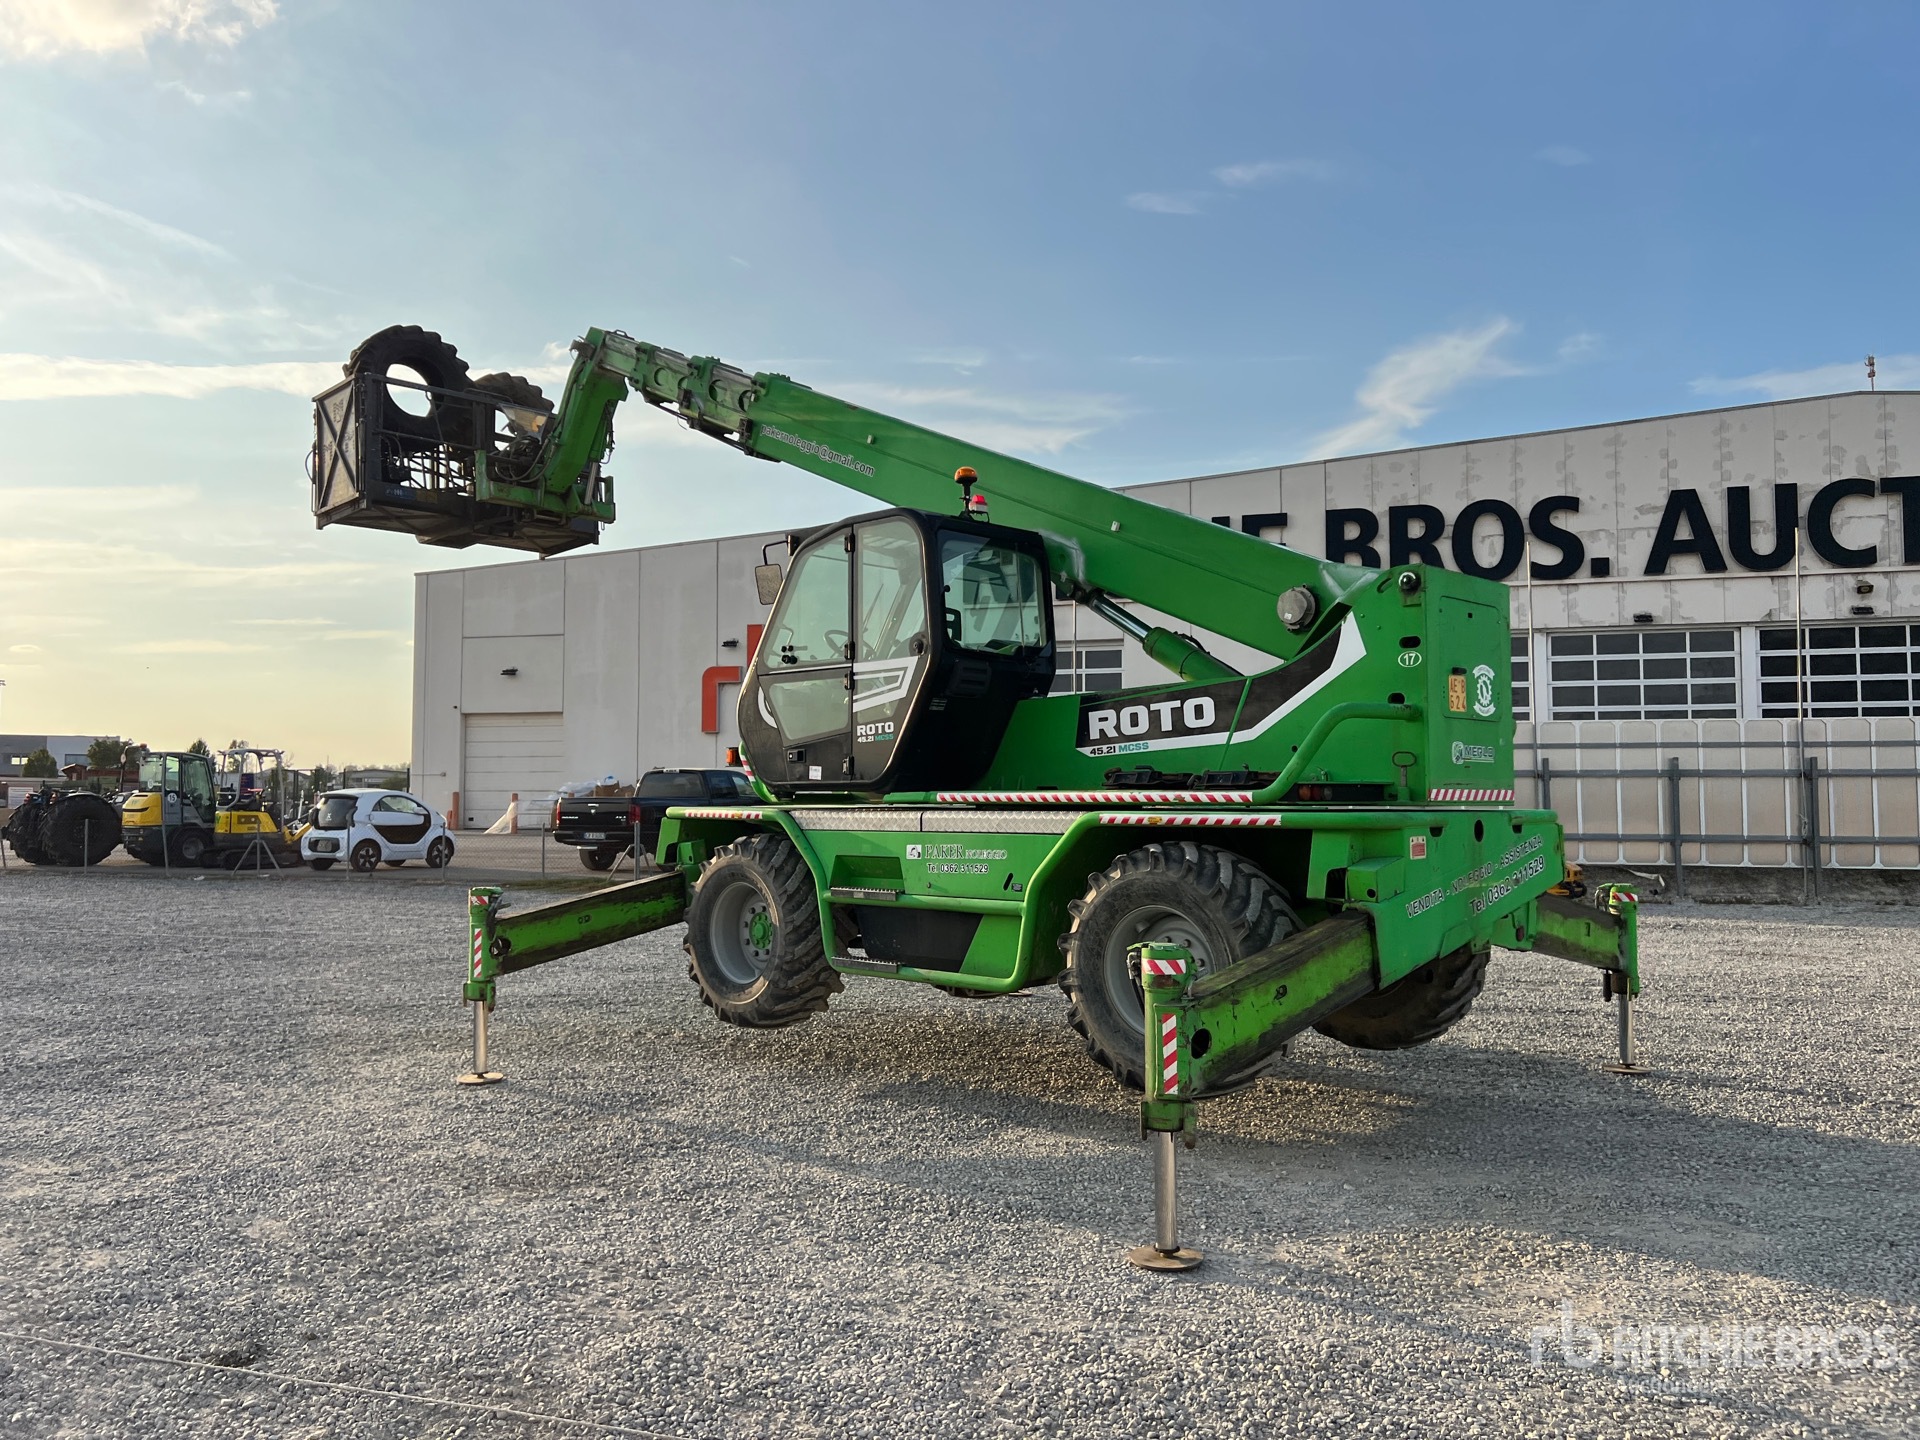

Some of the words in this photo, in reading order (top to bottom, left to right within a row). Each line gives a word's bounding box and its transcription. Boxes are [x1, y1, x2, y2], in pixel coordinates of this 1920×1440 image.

[761, 423, 875, 477] pakernoleggio@gmail.com
[1325, 496, 1611, 580] BROS.
[1643, 475, 1920, 575] AUCT
[1403, 653, 1415, 666] 17
[1088, 696, 1216, 740] ROTO
[857, 721, 895, 737] ROTO
[875, 733, 894, 741] MCSS
[1118, 742, 1150, 753] MCSS
[925, 844, 964, 859] PAKER
[940, 863, 959, 873] 0362
[960, 863, 989, 874] 311529
[1405, 887, 1445, 918] VENDITA
[1450, 861, 1493, 896] NOLEGGIO
[1499, 834, 1543, 870] ASSISTENZA
[1469, 893, 1487, 917] Tel
[1487, 876, 1512, 906] 0362
[1512, 855, 1545, 888] 311529
